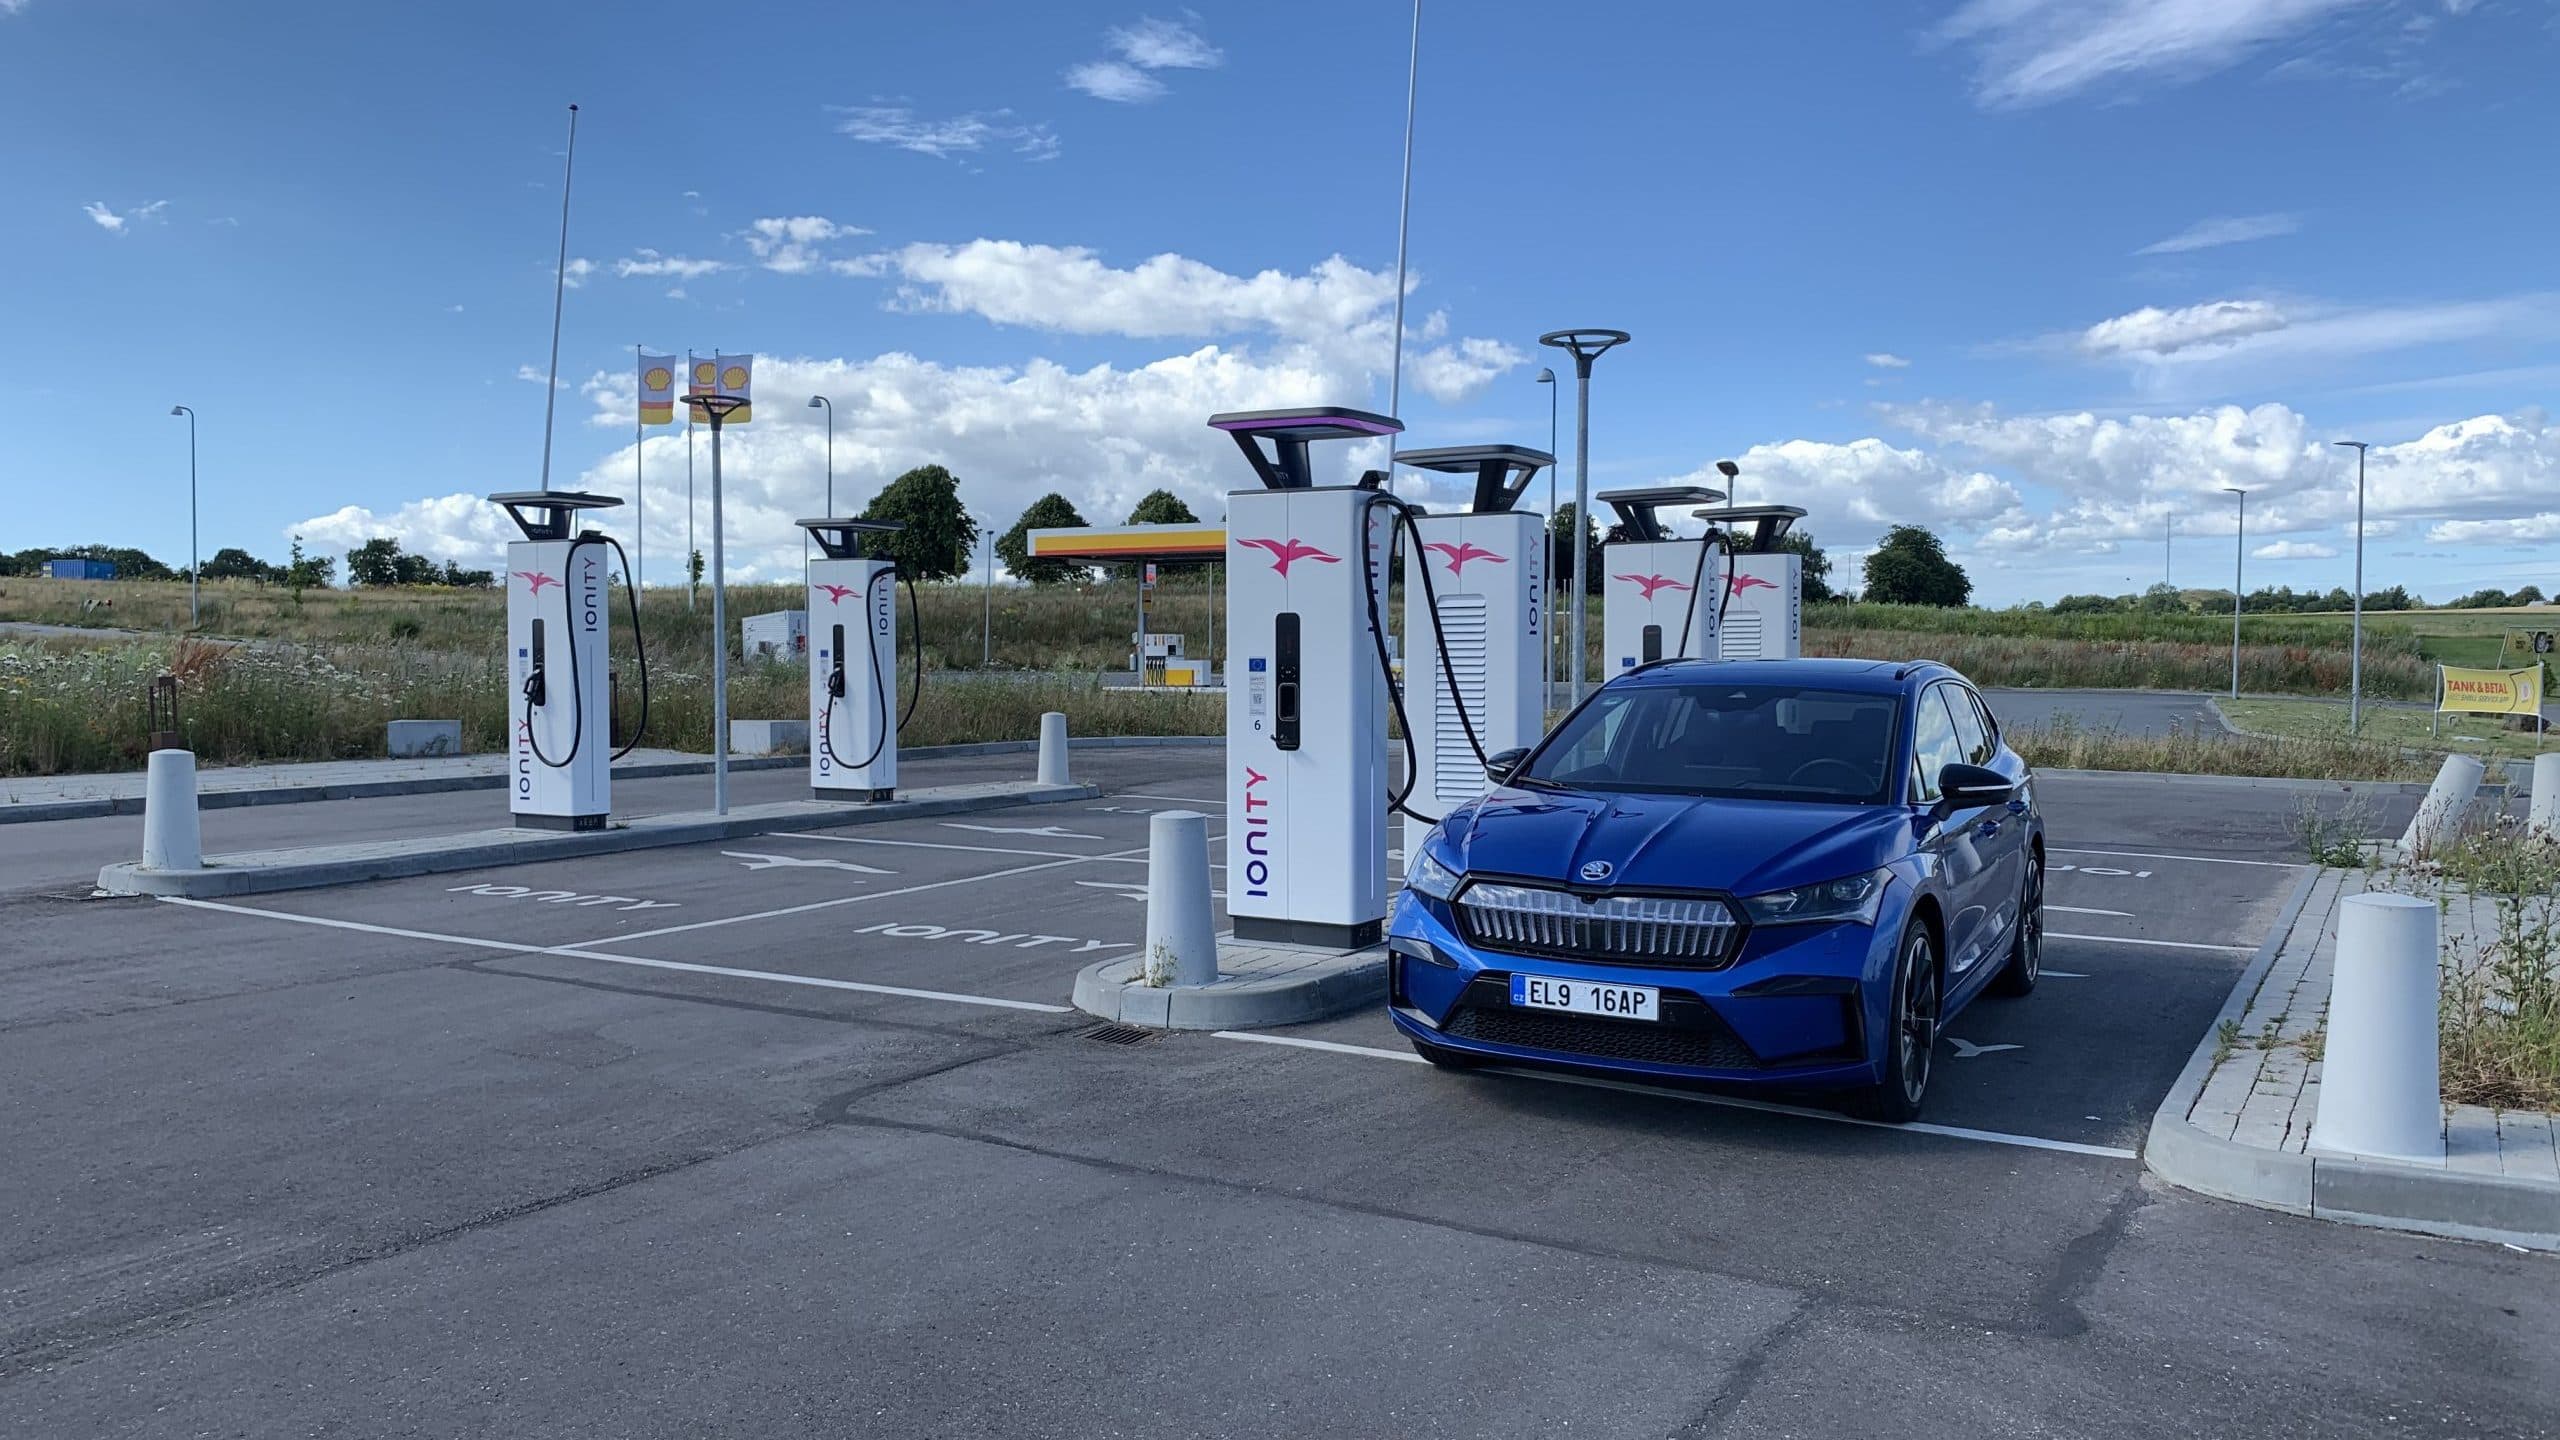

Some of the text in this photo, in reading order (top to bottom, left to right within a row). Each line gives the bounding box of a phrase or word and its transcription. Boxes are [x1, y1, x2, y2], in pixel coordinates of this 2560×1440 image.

[584, 557, 598, 632] IONITY
[878, 575, 889, 636] IONITY
[1529, 535, 1539, 636] IONITY
[2447, 680, 2508, 694] TANK & BETAL
[819, 708, 831, 777] IONITY
[1254, 719, 1261, 731] 6
[518, 717, 531, 800] IONITY
[1246, 766, 1268, 897] IONITY
[446, 883, 682, 911] IONITY
[853, 922, 1138, 952] IONITY
[1513, 993, 1525, 1002] CZ
[1530, 980, 1646, 1015] EL9 16AP
